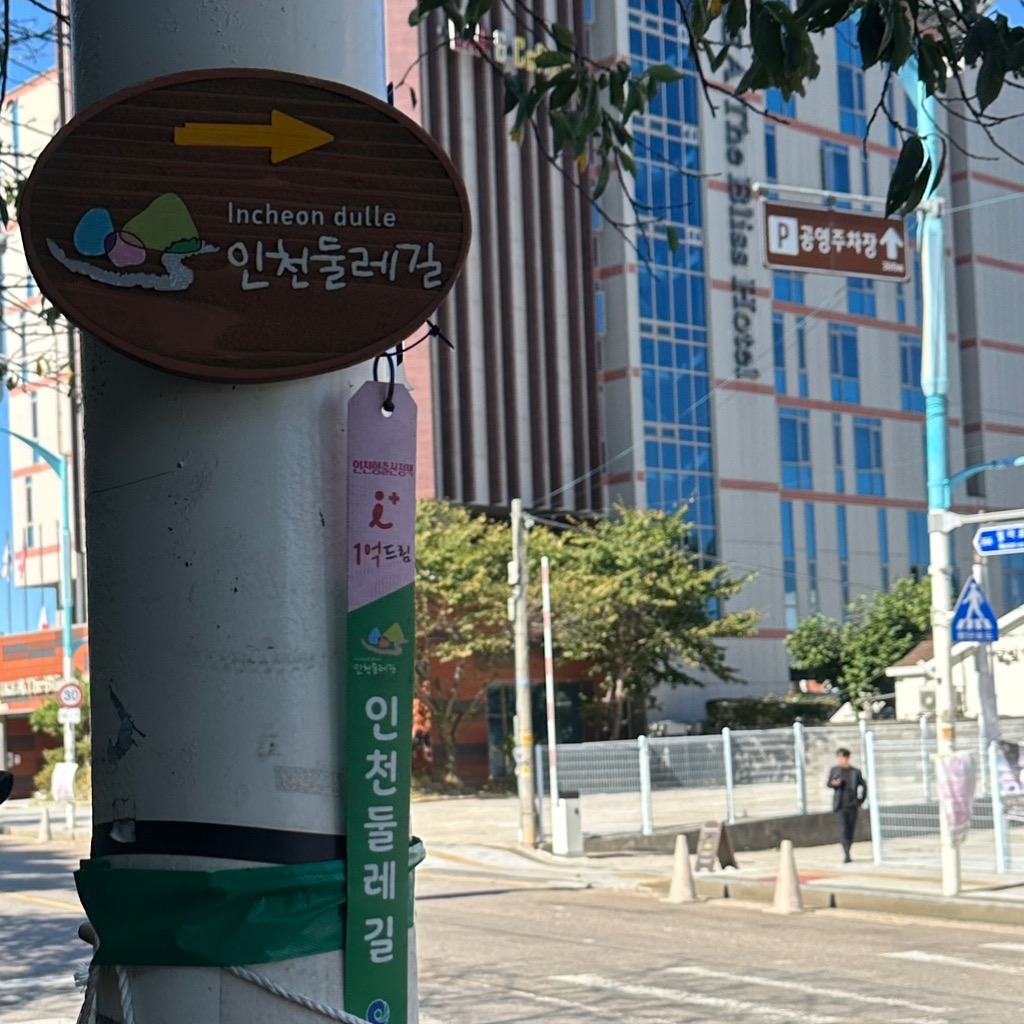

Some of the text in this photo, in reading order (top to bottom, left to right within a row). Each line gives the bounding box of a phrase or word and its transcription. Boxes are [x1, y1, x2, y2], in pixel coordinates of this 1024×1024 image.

[724, 100, 749, 166] The
[227, 201, 397, 228] Incheon dulle
[727, 176, 754, 267] Bliss
[800, 224, 878, 260] 공영주차장
[227, 236, 443, 291] 인천둘레길
[731, 275, 760, 380] Hotel
[363, 695, 399, 964] 인천둘레길
